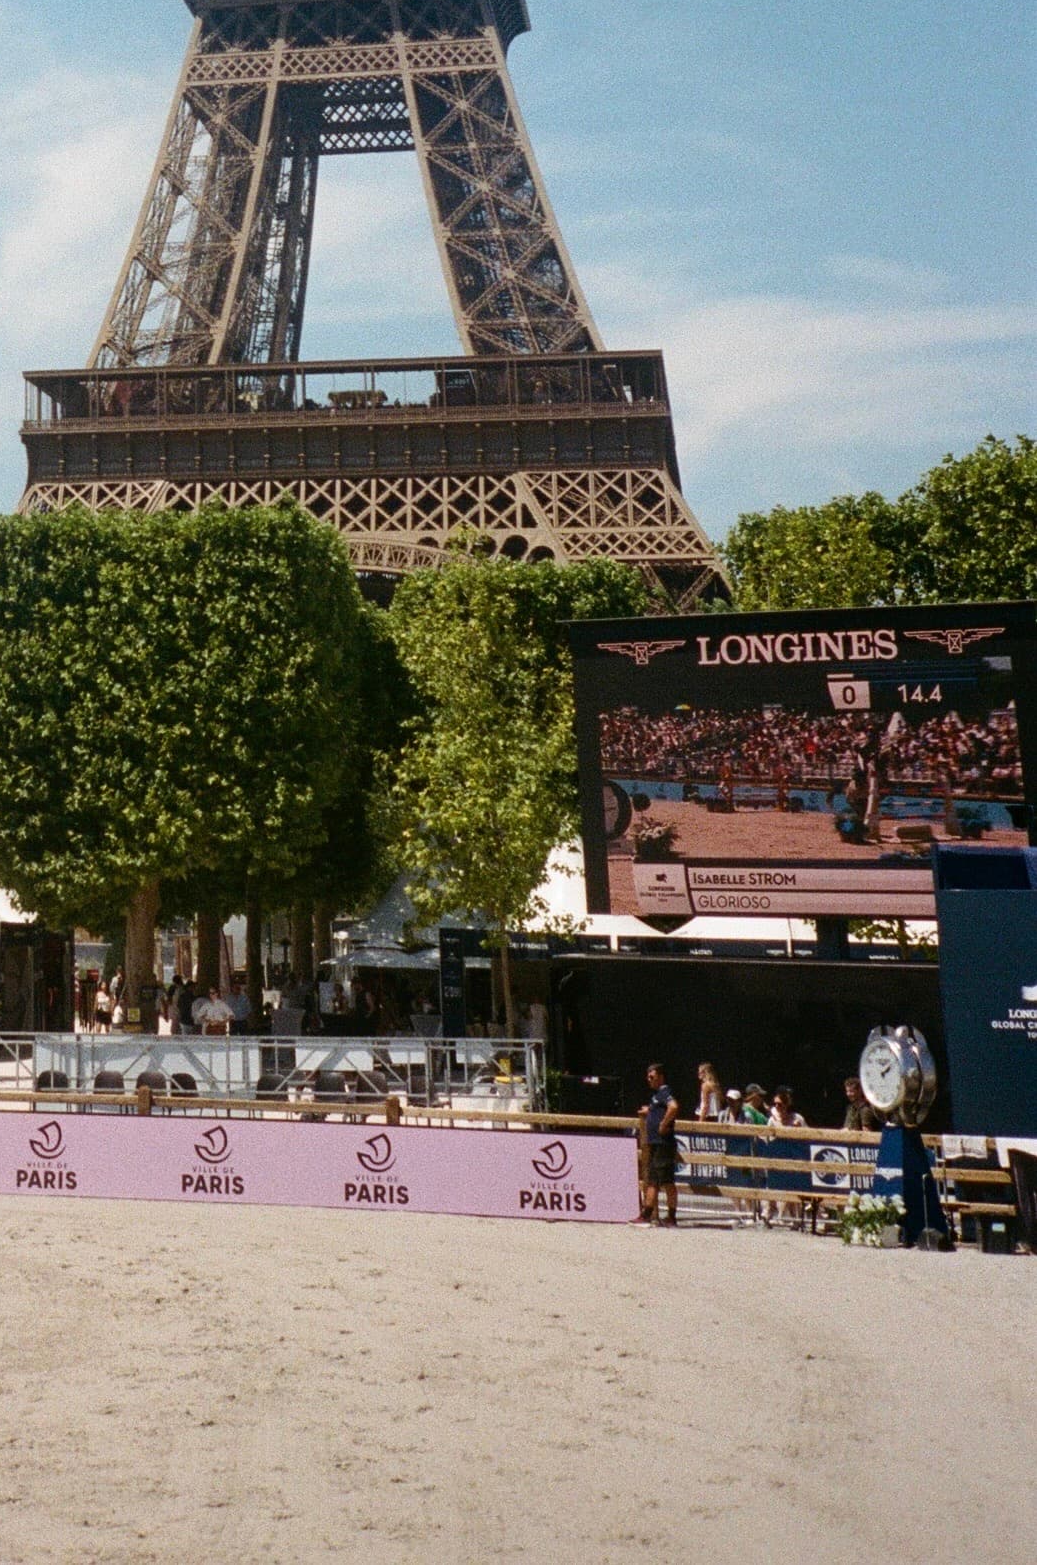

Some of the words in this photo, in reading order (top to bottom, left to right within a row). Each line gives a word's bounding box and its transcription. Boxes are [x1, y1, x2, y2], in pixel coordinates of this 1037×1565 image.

[697, 629, 899, 666] LONGINES
[842, 686, 857, 705] 0
[897, 684, 943, 704] 14.4
[749, 873, 797, 886] STROM
[698, 895, 771, 909] GLORIOSO
[991, 1021, 1026, 1030] GLOBAL
[17, 1170, 77, 1190] PARIS
[181, 1174, 245, 1195] PARIS
[344, 1183, 409, 1205] PARIS
[519, 1190, 587, 1212] PARIS
